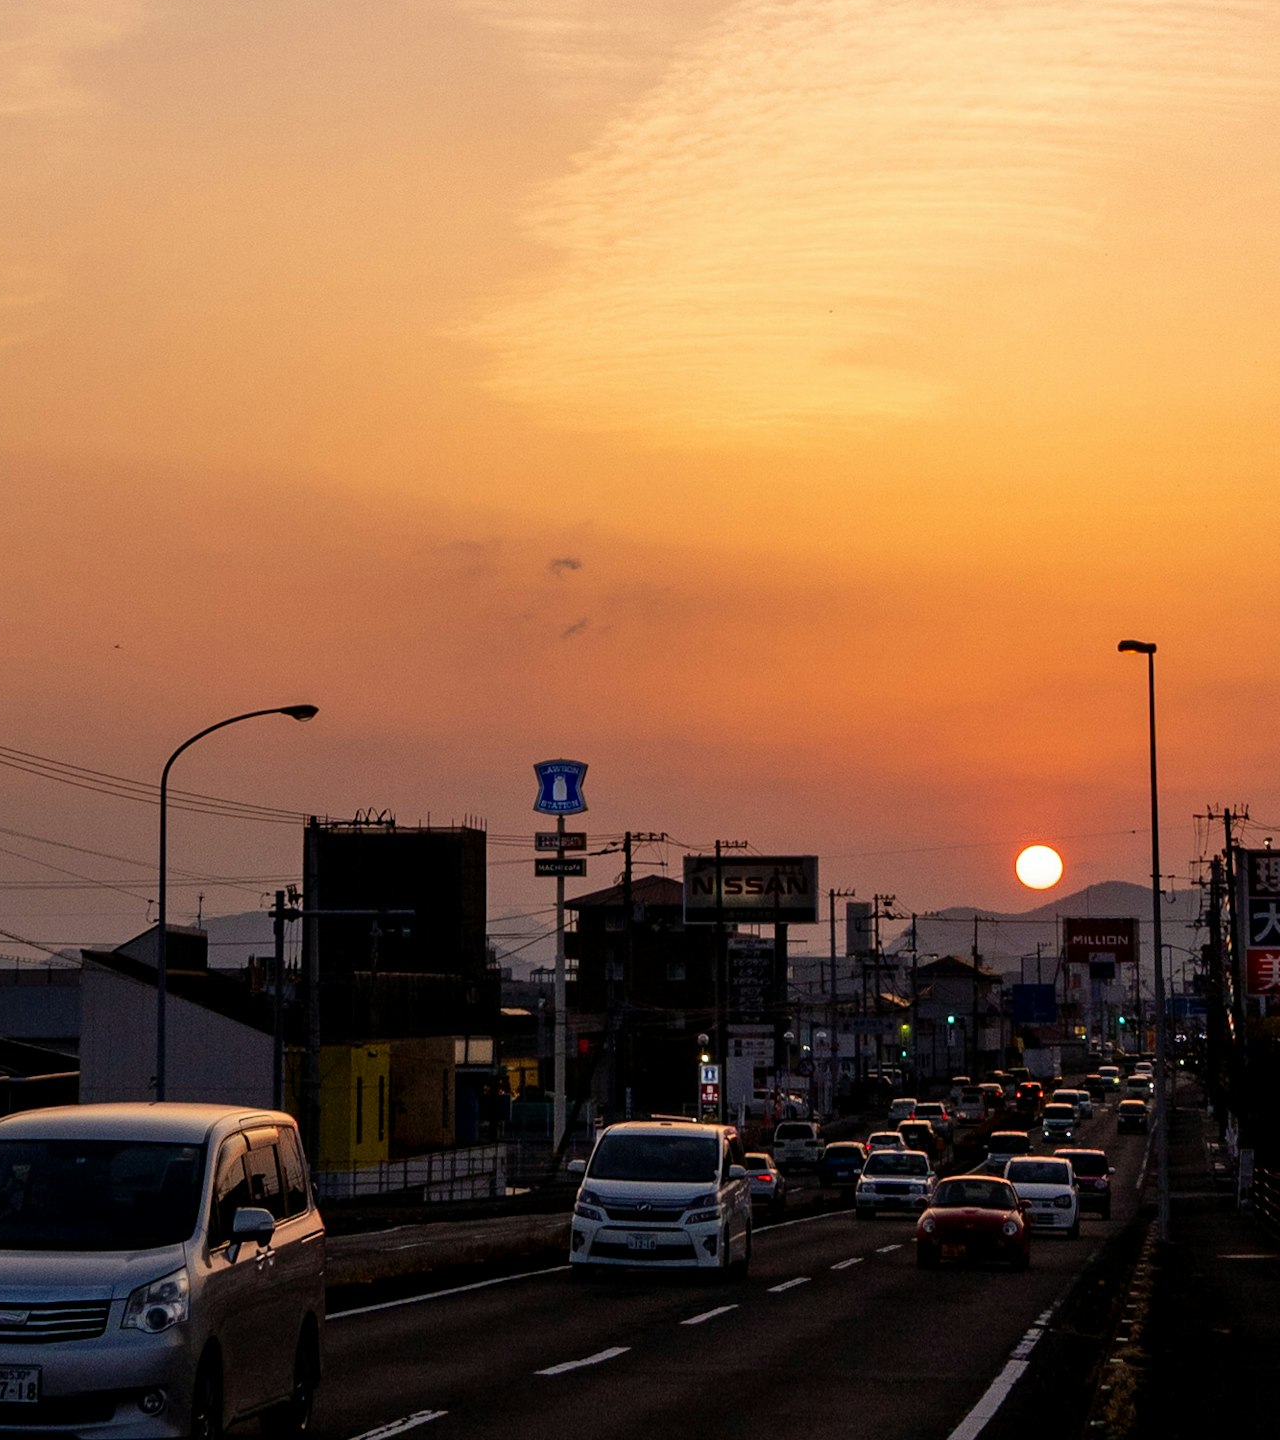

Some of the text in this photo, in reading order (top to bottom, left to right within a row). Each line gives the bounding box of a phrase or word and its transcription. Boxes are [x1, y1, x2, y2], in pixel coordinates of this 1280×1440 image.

[540, 764, 580, 775] LAWSON
[540, 799, 580, 810] STATION
[692, 877, 809, 895] NSSAN
[1072, 935, 1129, 946] MILLION
